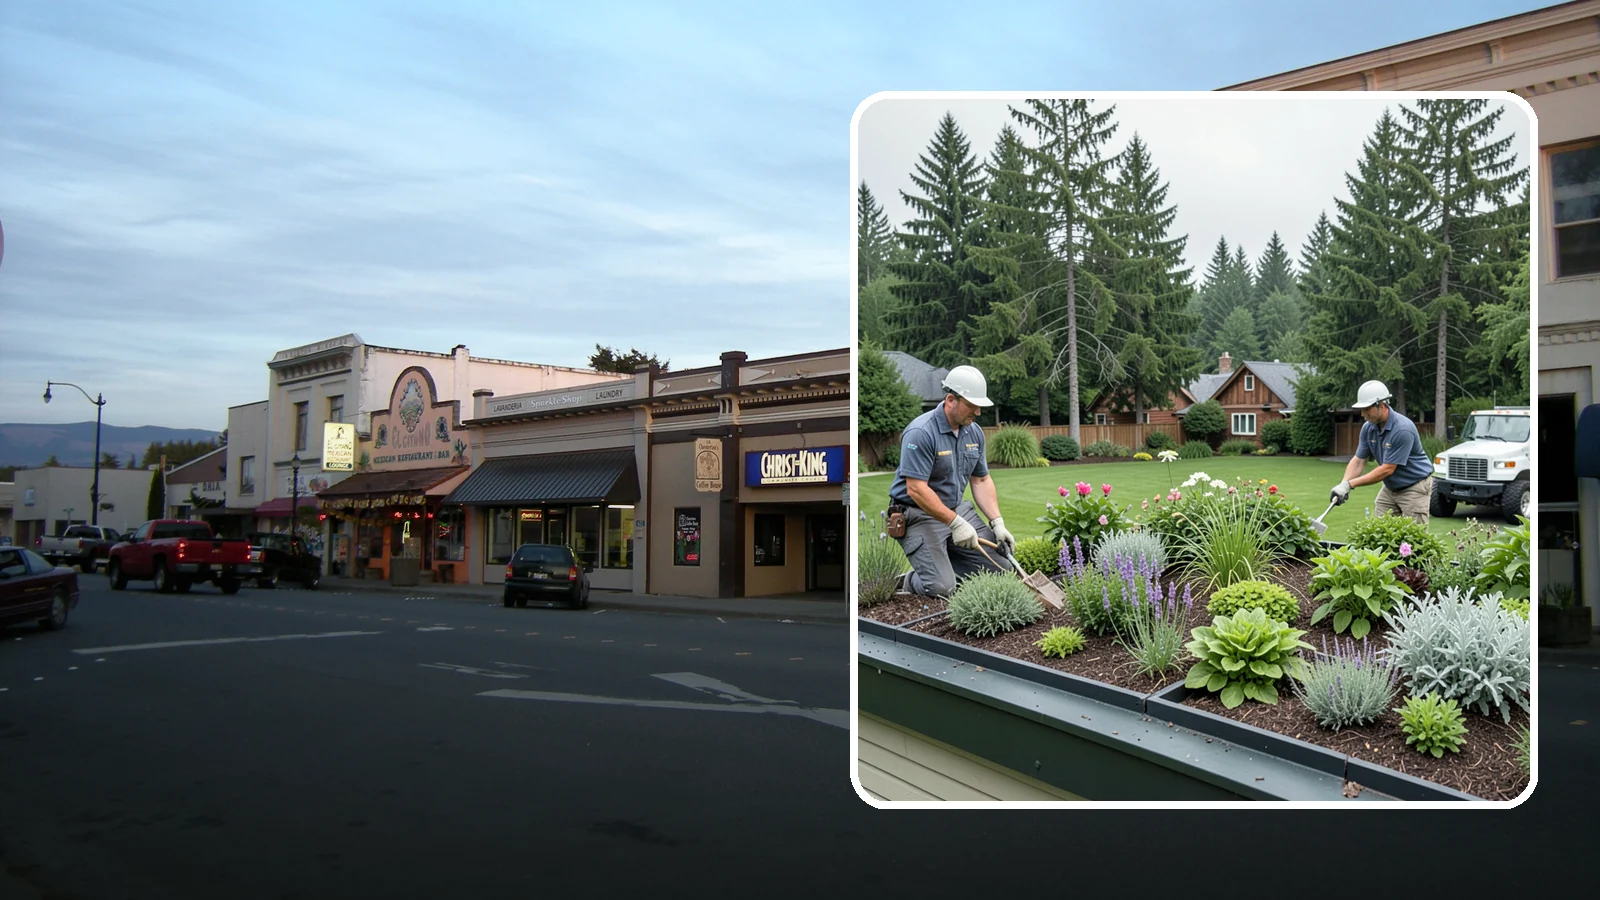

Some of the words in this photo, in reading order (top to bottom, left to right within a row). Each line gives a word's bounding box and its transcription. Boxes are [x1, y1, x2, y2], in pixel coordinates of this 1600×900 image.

[493, 402, 523, 413] LAVANDERIA
[531, 398, 560, 409] Sparkle
[561, 395, 583, 407] Shop
[595, 389, 623, 400] LAUNDRY
[373, 455, 396, 464] MEXICAN
[397, 451, 434, 463] RESTAURANT
[438, 450, 450, 459] BAR
[760, 452, 797, 478] CHRIST
[798, 449, 828, 476] KING
[696, 481, 709, 489] Coffee
